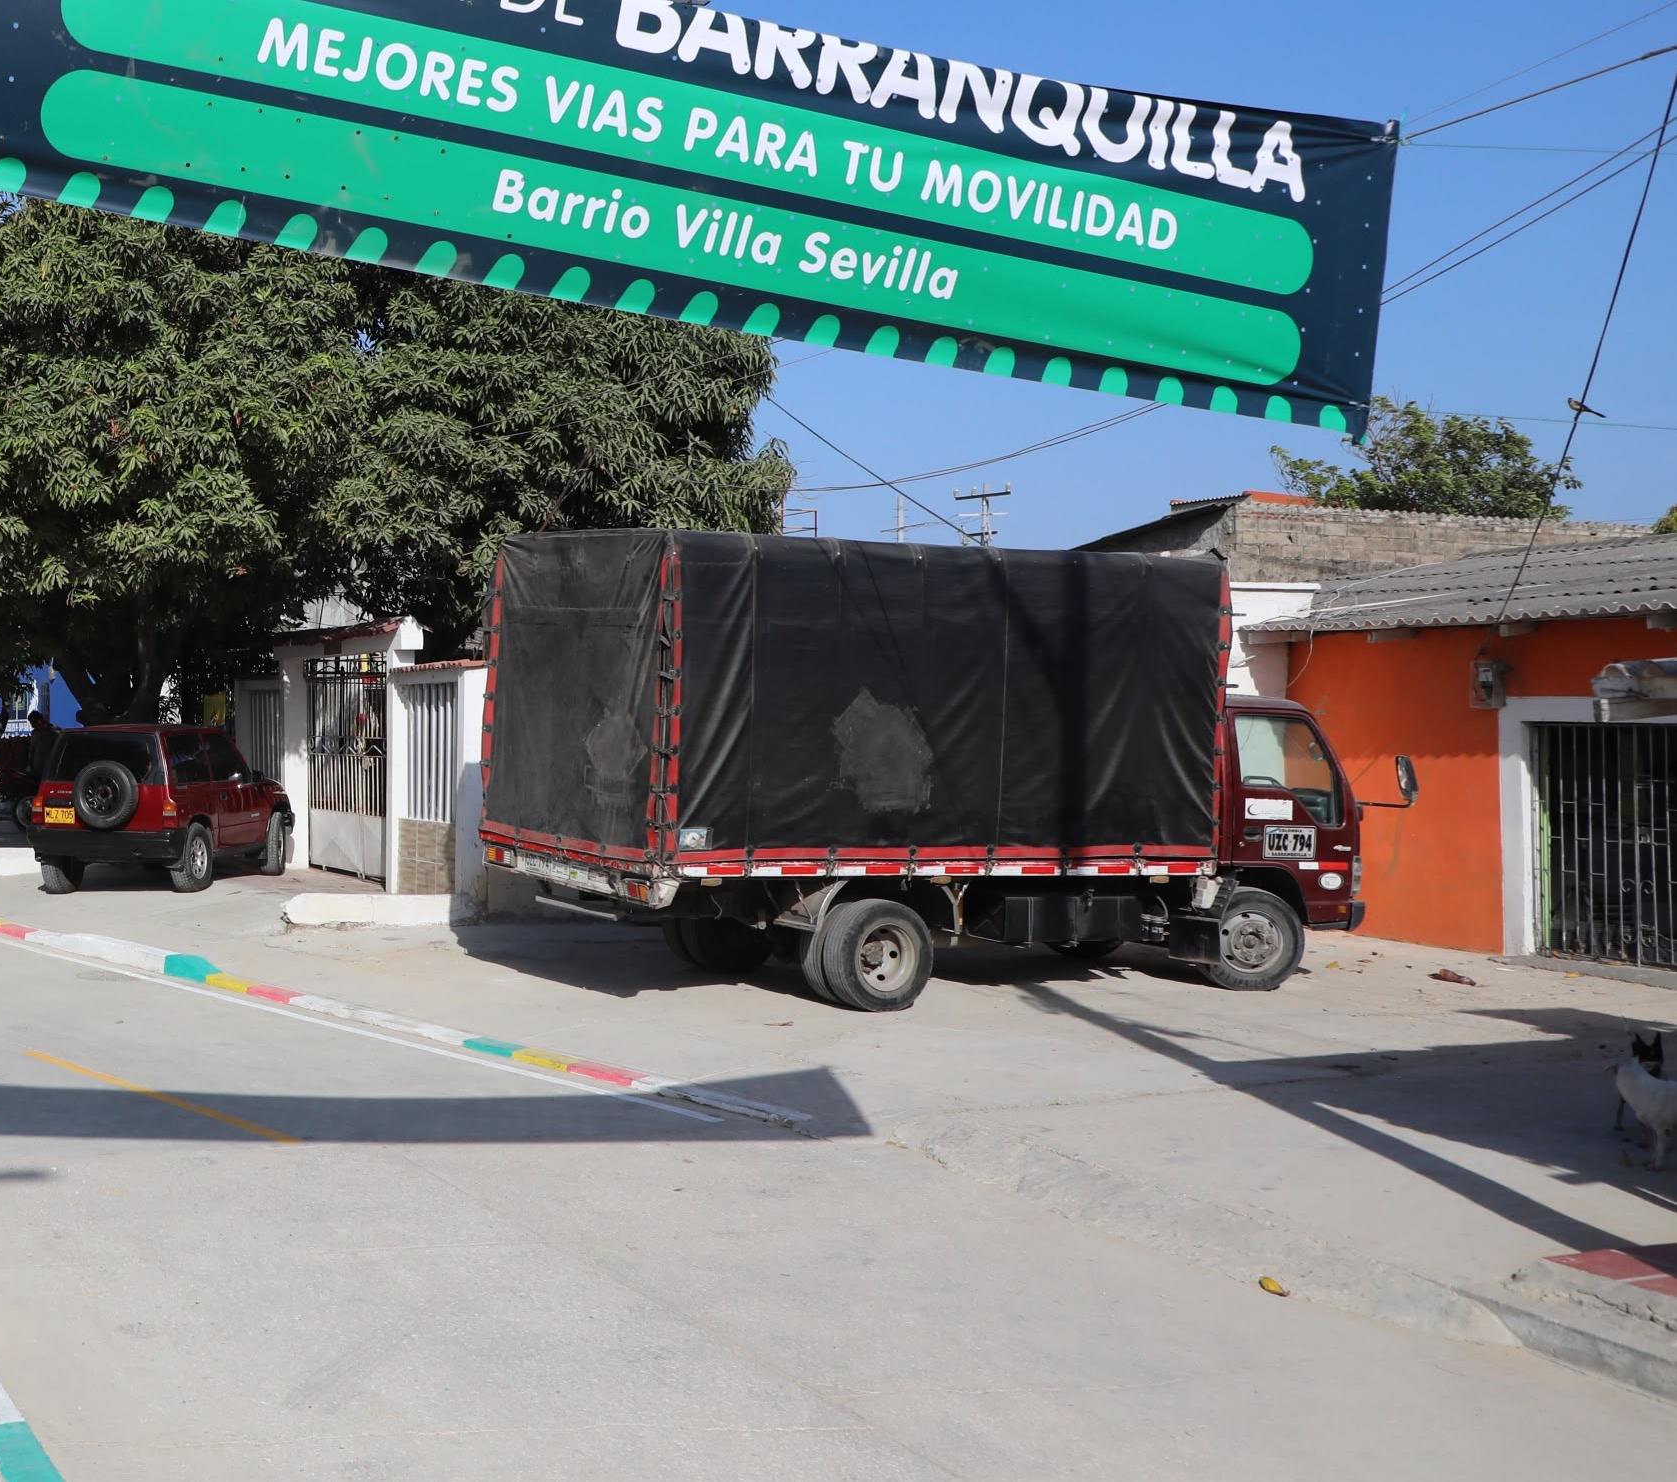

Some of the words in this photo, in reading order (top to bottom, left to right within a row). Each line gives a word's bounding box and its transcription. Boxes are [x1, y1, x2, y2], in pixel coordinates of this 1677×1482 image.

[257, 17, 519, 112] MEJORES
[545, 75, 663, 143] VIAS
[684, 107, 818, 177] PARA
[844, 140, 904, 192] TU
[921, 159, 1178, 249] MOVILIDAD
[615, 0, 1306, 203] BARRANQUILLA
[492, 169, 650, 239] Barrio
[676, 204, 782, 265] Villa
[798, 231, 958, 299] Sevilla
[1268, 833, 1289, 852] UZC
[1292, 834, 1312, 851] 794
